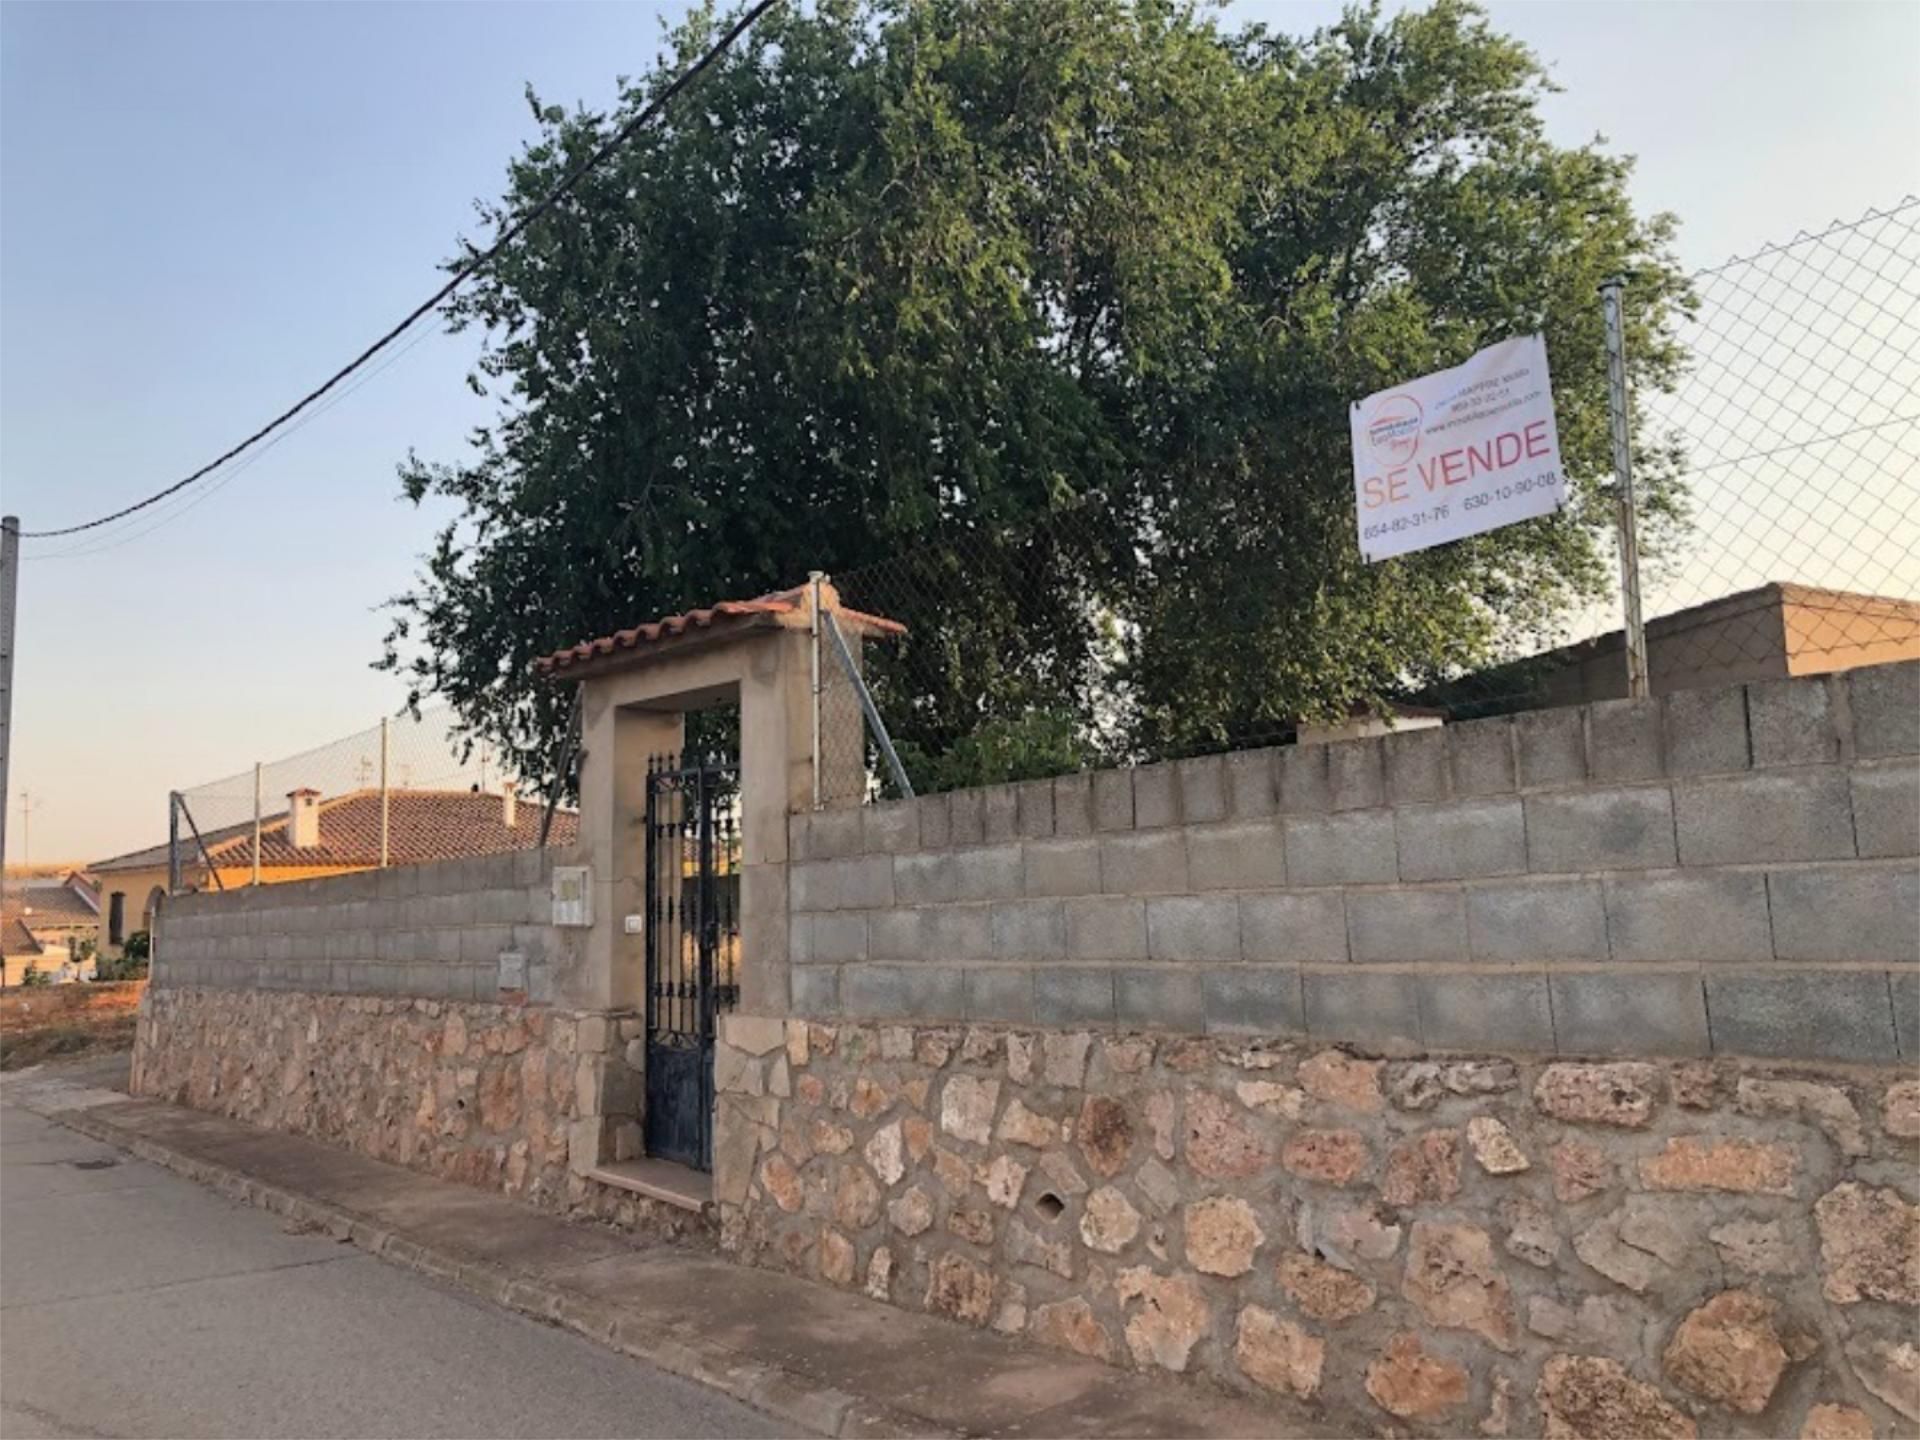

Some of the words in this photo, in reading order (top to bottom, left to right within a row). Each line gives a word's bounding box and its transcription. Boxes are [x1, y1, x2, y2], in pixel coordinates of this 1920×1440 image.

[1363, 468, 1410, 509] SE
[1417, 420, 1550, 492] VENDE
[1364, 505, 1450, 540] 654-82-31-76
[1464, 471, 1557, 511] 630-10-90-08
